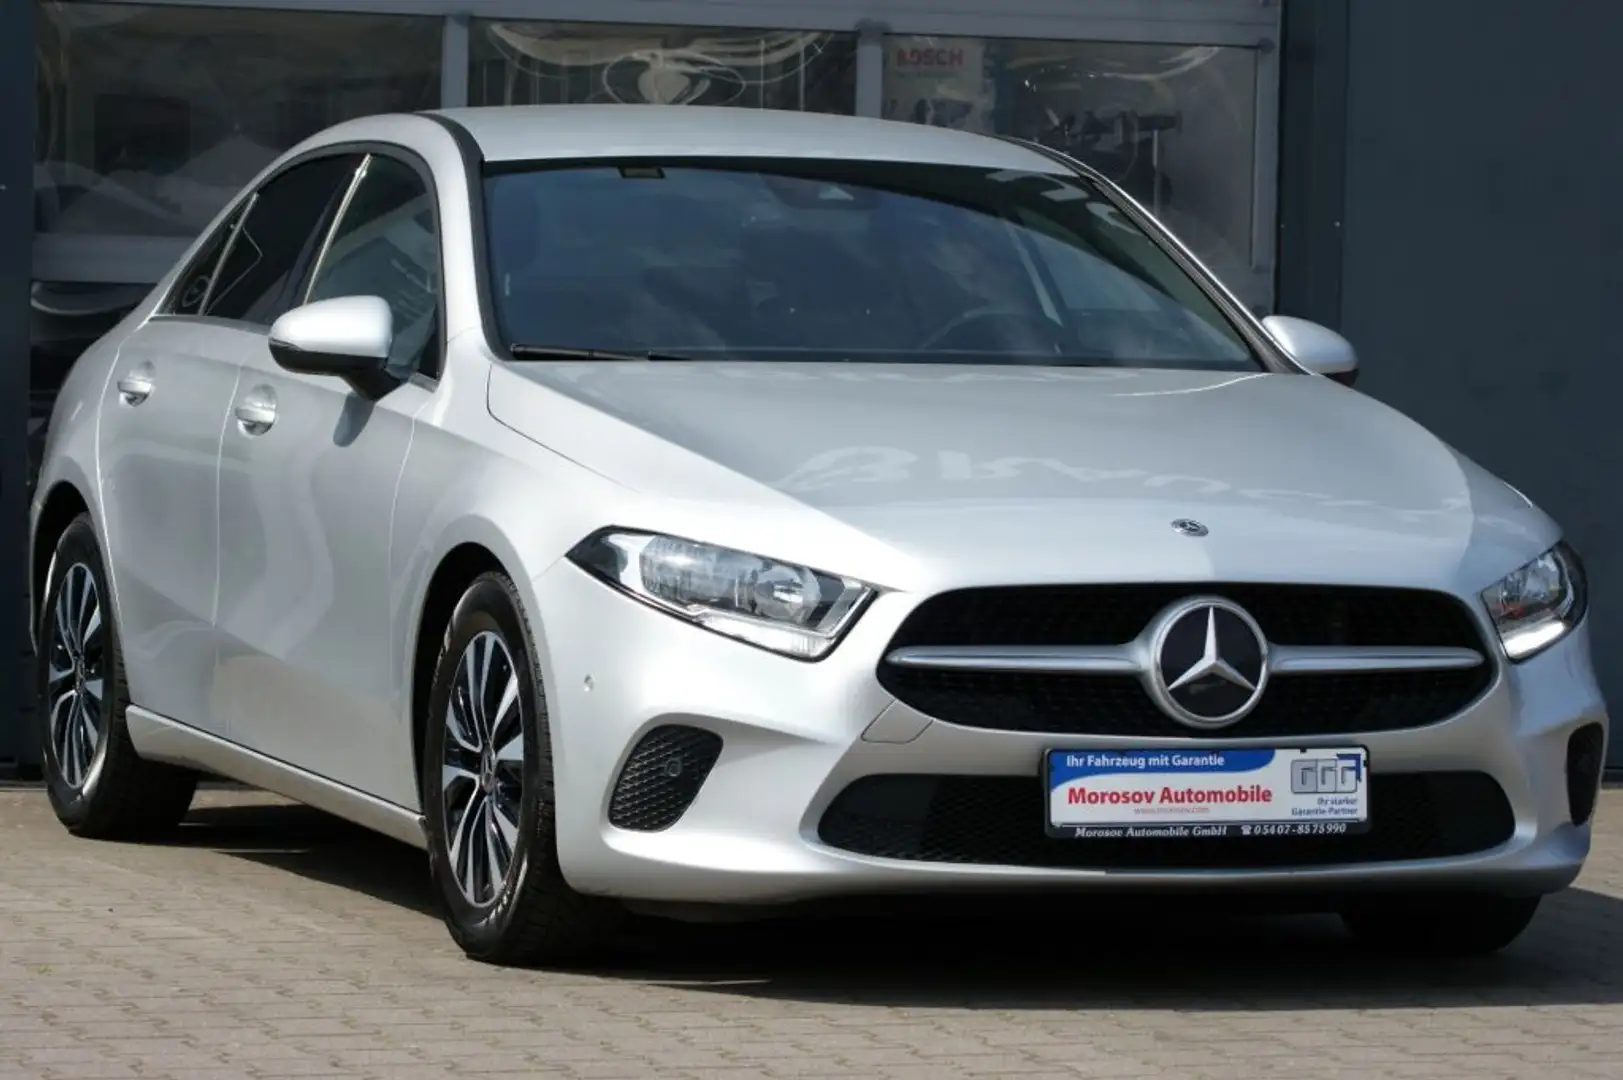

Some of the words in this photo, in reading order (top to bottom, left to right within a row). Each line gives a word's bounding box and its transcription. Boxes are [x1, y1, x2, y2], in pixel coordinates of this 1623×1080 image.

[1066, 754, 1084, 767] Ihr
[1087, 754, 1146, 769] Fahrzeug
[1149, 753, 1169, 766] mit
[1171, 753, 1225, 766] Garantie
[1068, 787, 1155, 805] Morosov
[1158, 784, 1272, 804] Automobile
[1075, 827, 1122, 837] Morosov
[1126, 826, 1189, 837] Automobile
[1192, 825, 1227, 837] GmbH
